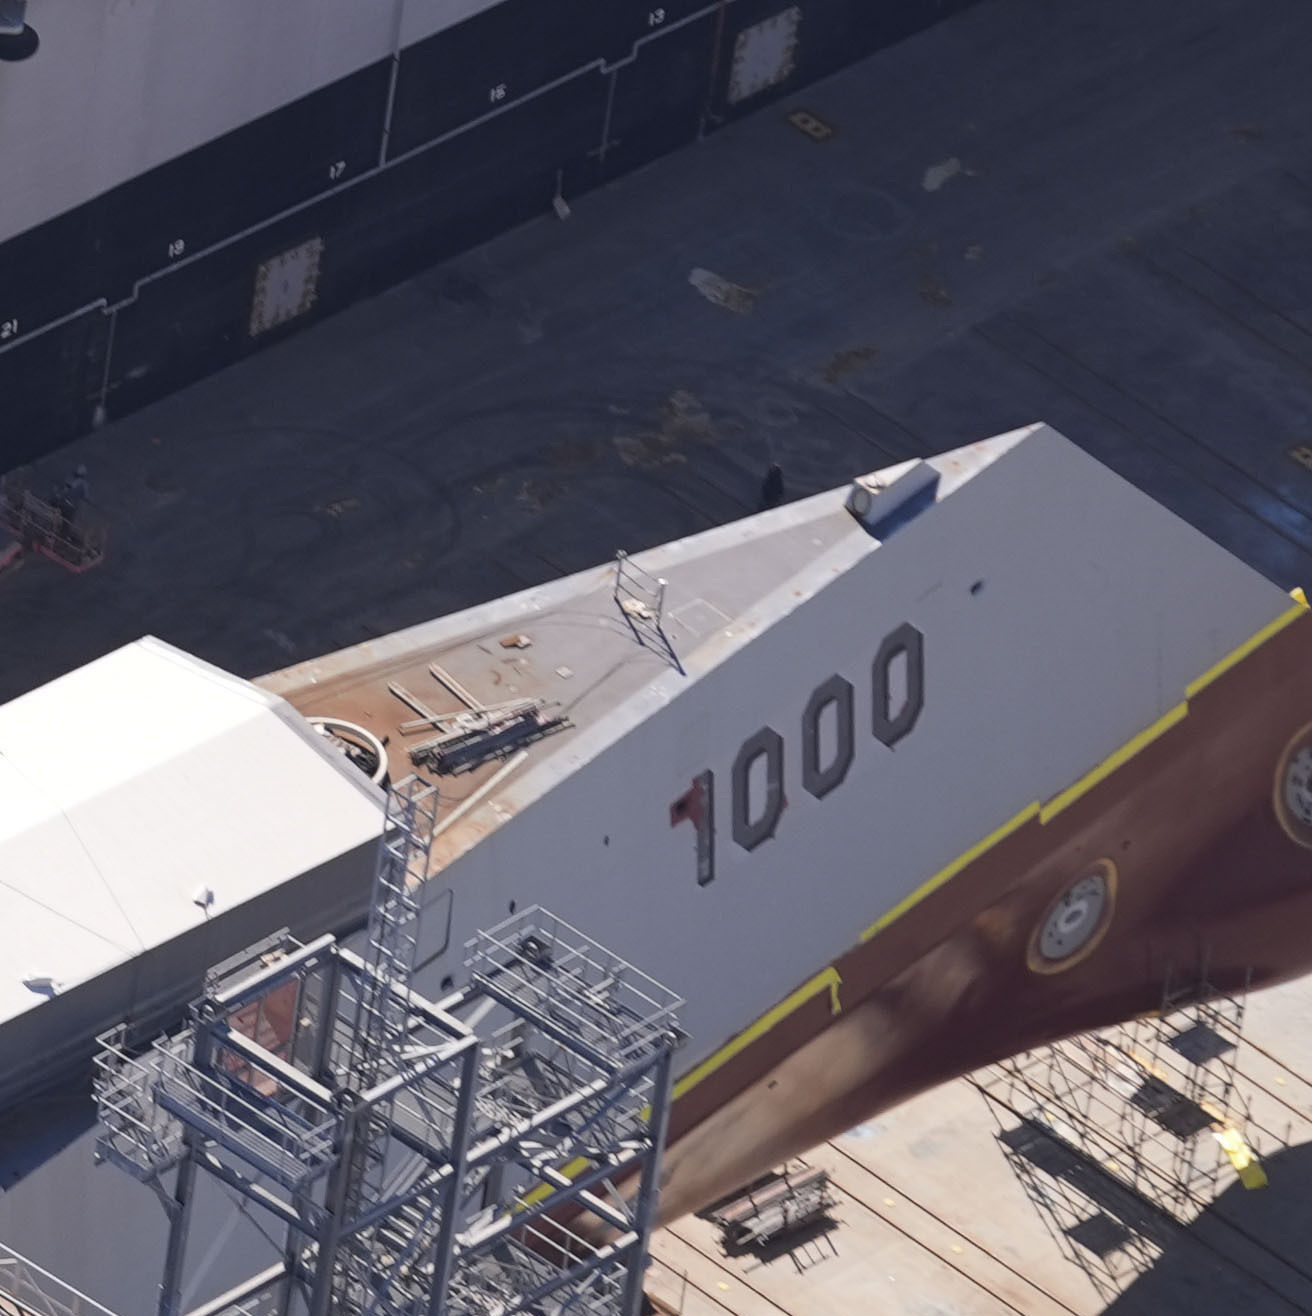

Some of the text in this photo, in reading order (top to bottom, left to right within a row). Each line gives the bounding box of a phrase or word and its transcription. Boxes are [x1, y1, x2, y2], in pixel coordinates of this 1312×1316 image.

[329, 160, 346, 179] 17
[167, 239, 185, 258] 19
[0, 319, 18, 340] 21
[670, 621, 925, 888] 1000
